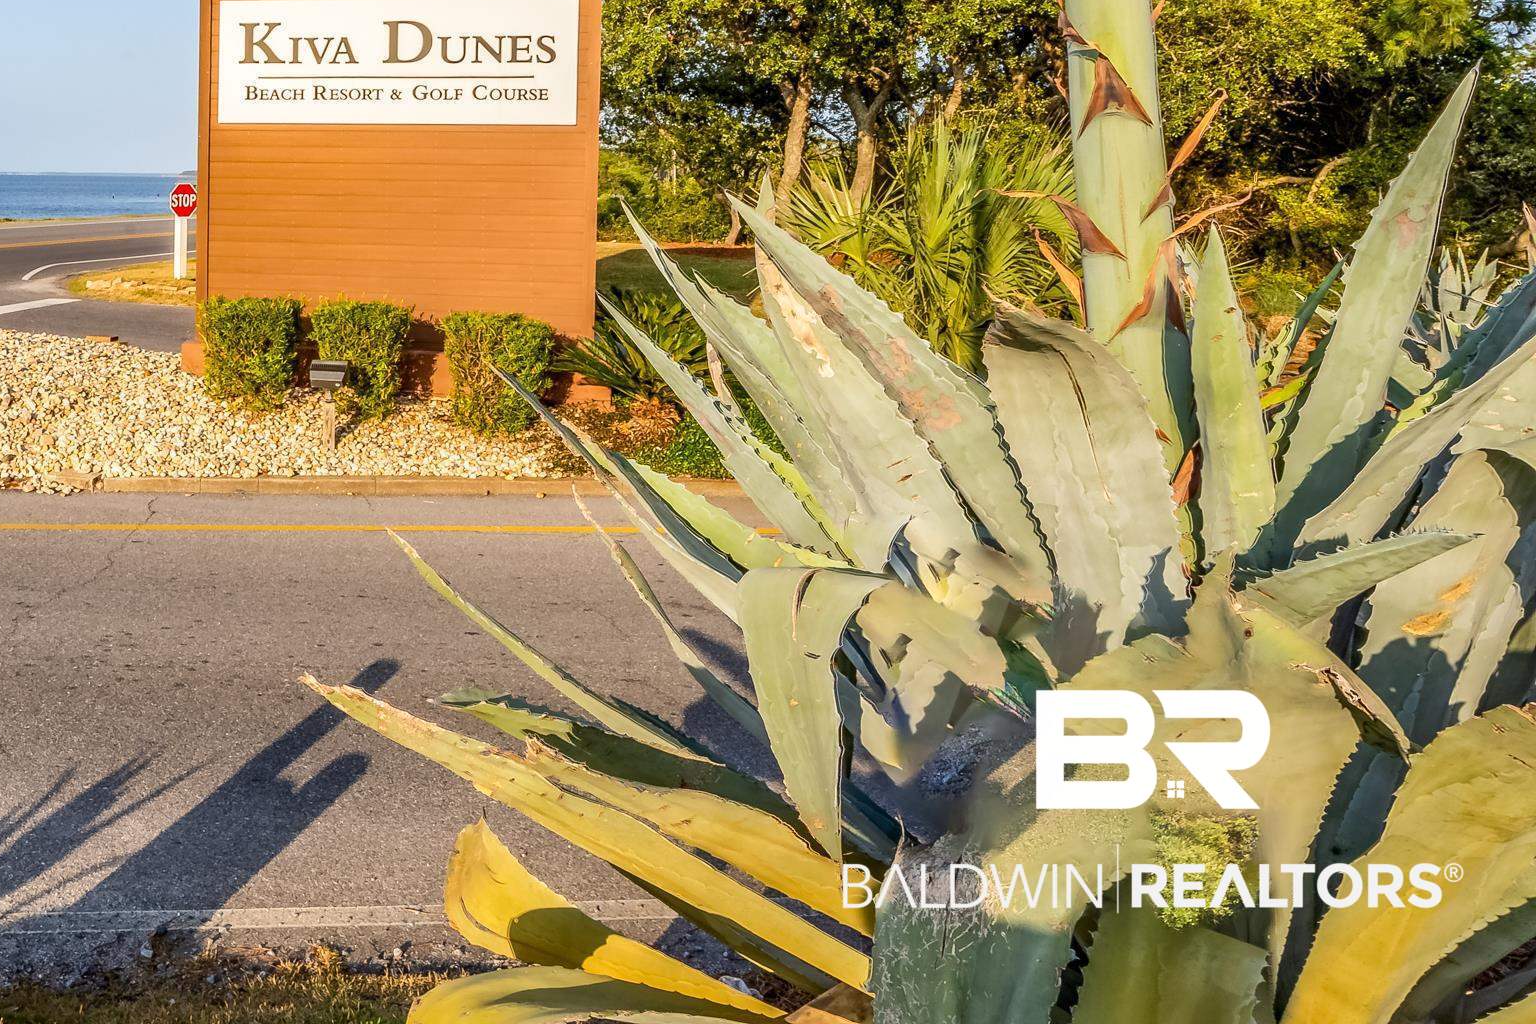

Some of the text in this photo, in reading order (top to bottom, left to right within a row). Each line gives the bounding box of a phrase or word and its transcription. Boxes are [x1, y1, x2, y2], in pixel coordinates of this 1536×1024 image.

[238, 20, 557, 64] KIVA DUNES
[244, 84, 549, 101] BEACH RESORT & GOLF COURSE
[171, 193, 197, 208] STOP
